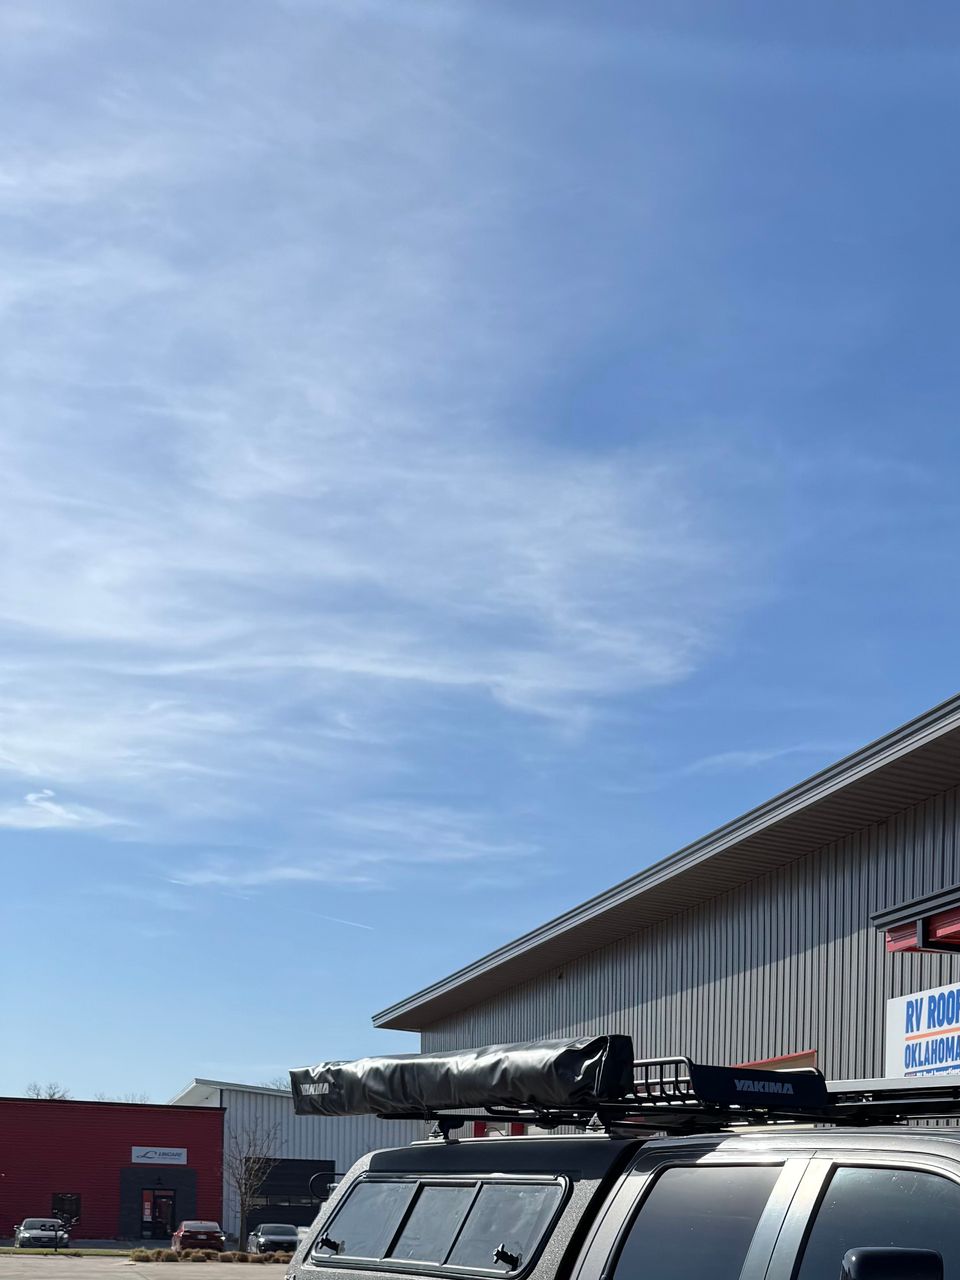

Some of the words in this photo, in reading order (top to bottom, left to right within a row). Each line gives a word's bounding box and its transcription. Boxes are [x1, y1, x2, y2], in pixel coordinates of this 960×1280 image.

[905, 997, 924, 1033] RV
[300, 1082, 329, 1096] YAKIMA
[734, 1079, 794, 1095] YAKIMA
